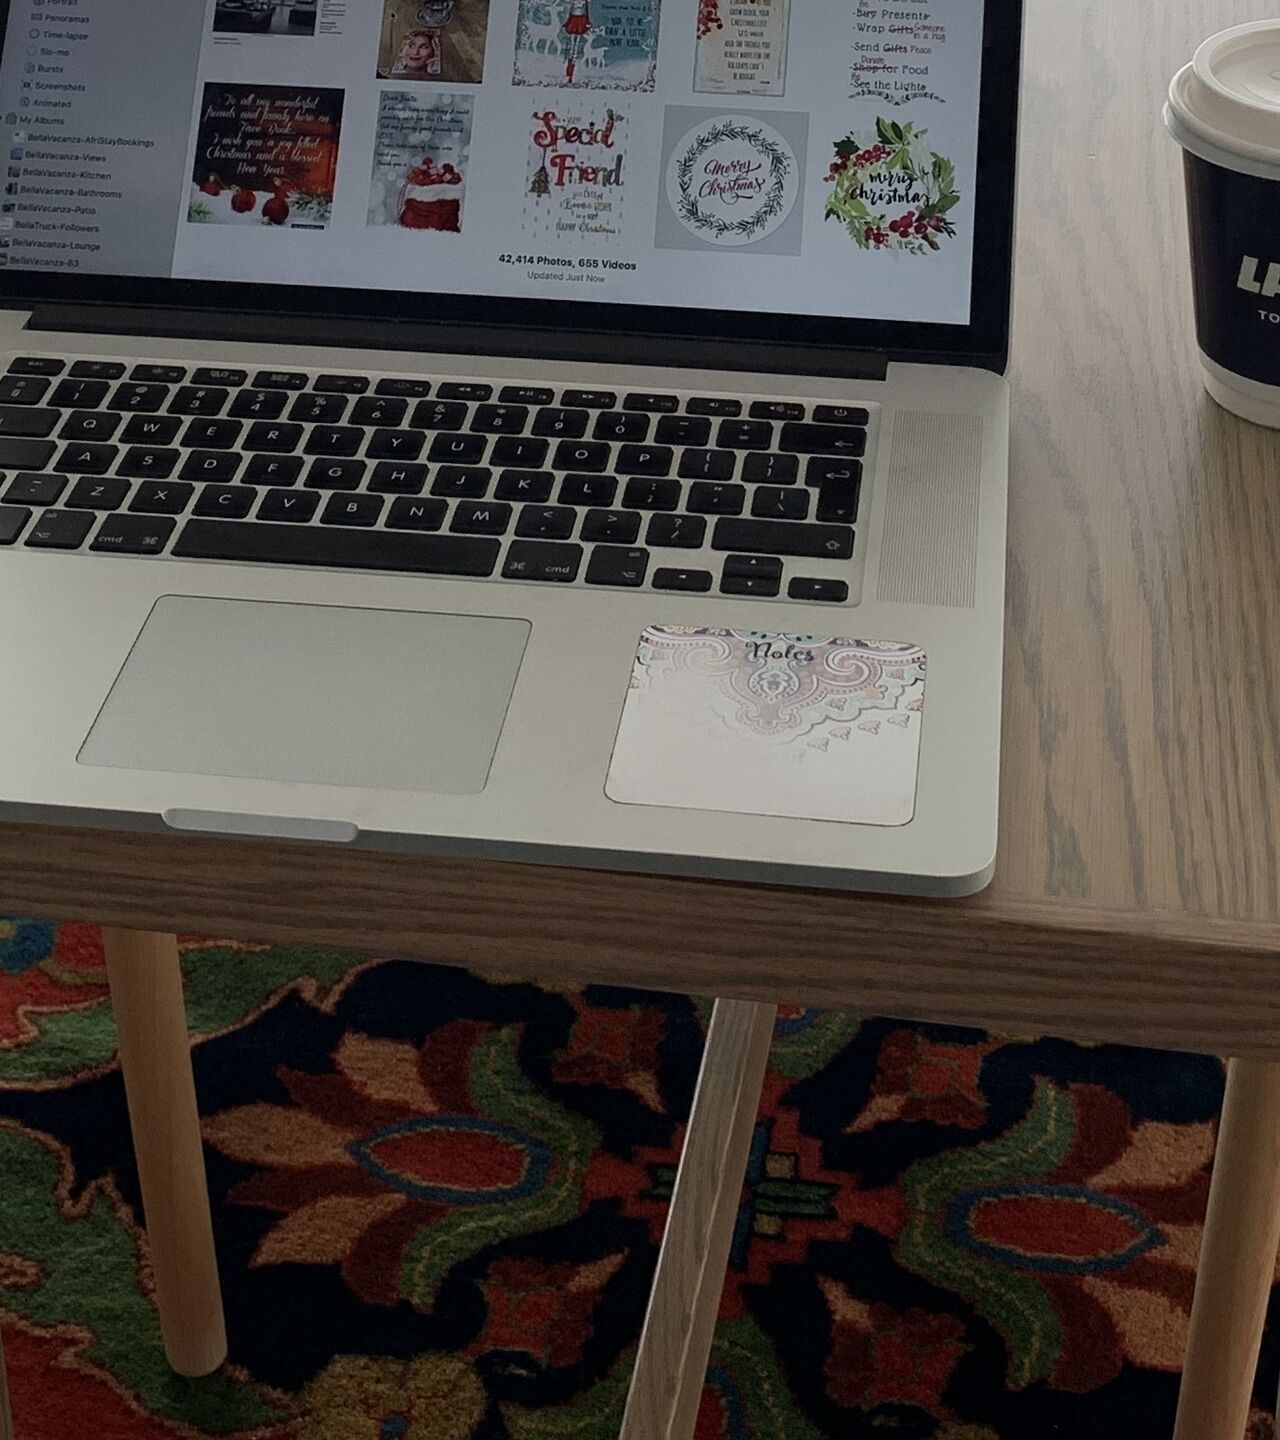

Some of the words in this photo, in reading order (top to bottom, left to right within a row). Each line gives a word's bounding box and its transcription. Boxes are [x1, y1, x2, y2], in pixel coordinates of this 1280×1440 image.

[44, 14, 90, 24] Panoramas
[43, 31, 88, 41] Time-lapse
[888, 24, 913, 35] Gifts
[39, 47, 69, 57] Slo-mo
[883, 43, 908, 54] Gifts
[910, 45, 933, 54] Peace
[37, 64, 64, 73] Bursts
[902, 65, 929, 75] Food
[35, 81, 86, 92] Screenshots
[874, 79, 890, 90] the
[32, 99, 72, 108] Animated
[240, 94, 255, 106] all
[274, 96, 320, 114] wonderful
[240, 106, 259, 120] and
[20, 116, 32, 126] My
[34, 116, 65, 126] Albums
[533, 109, 615, 151] Special
[222, 133, 241, 146] wish
[245, 137, 263, 152] you
[25, 150, 106, 163] BellaVacanza-Views
[206, 147, 251, 160] Christmas
[256, 150, 274, 161] and
[290, 148, 322, 163] blessed
[23, 168, 111, 181] BellaVacanza-Kitchen
[550, 154, 624, 187] Friend
[704, 159, 762, 178] Merry
[869, 171, 918, 191] merry
[20, 185, 122, 199] BellaVacanza-Bathrooms
[699, 176, 766, 201] Christmas
[850, 183, 929, 208] christmas
[17, 203, 96, 216] BellaVacanza-Patio
[12, 238, 101, 252] BellaVacanza-Lounge
[498, 254, 534, 265] 42,414
[536, 256, 575, 268] Photos,
[578, 258, 599, 268] 655
[601, 259, 637, 271] Videos
[527, 271, 563, 281] Updated
[566, 273, 584, 282] Just
[586, 275, 606, 283] Now
[83, 419, 97, 428] Q
[144, 423, 161, 432] W
[206, 427, 217, 435] E
[267, 431, 278, 440] R
[331, 434, 341, 443] T
[392, 438, 403, 447] Y
[452, 441, 465, 450] U
[575, 449, 588, 459] O
[639, 453, 651, 463] P
[79, 452, 91, 461] A
[142, 455, 154, 464] S
[204, 459, 218, 468] D
[268, 463, 279, 472] F
[329, 467, 343, 476] G
[391, 471, 406, 480] H
[456, 475, 466, 485] J
[518, 479, 531, 489] K
[583, 482, 593, 492] L
[90, 486, 105, 495] Z
[153, 491, 169, 500] X
[219, 494, 233, 503] C
[283, 498, 297, 508] V
[347, 502, 359, 512] B
[410, 506, 424, 516] N
[472, 510, 490, 520] M
[98, 535, 123, 544] cmd
[545, 563, 570, 574] cmd
[746, 641, 815, 662] Notes
